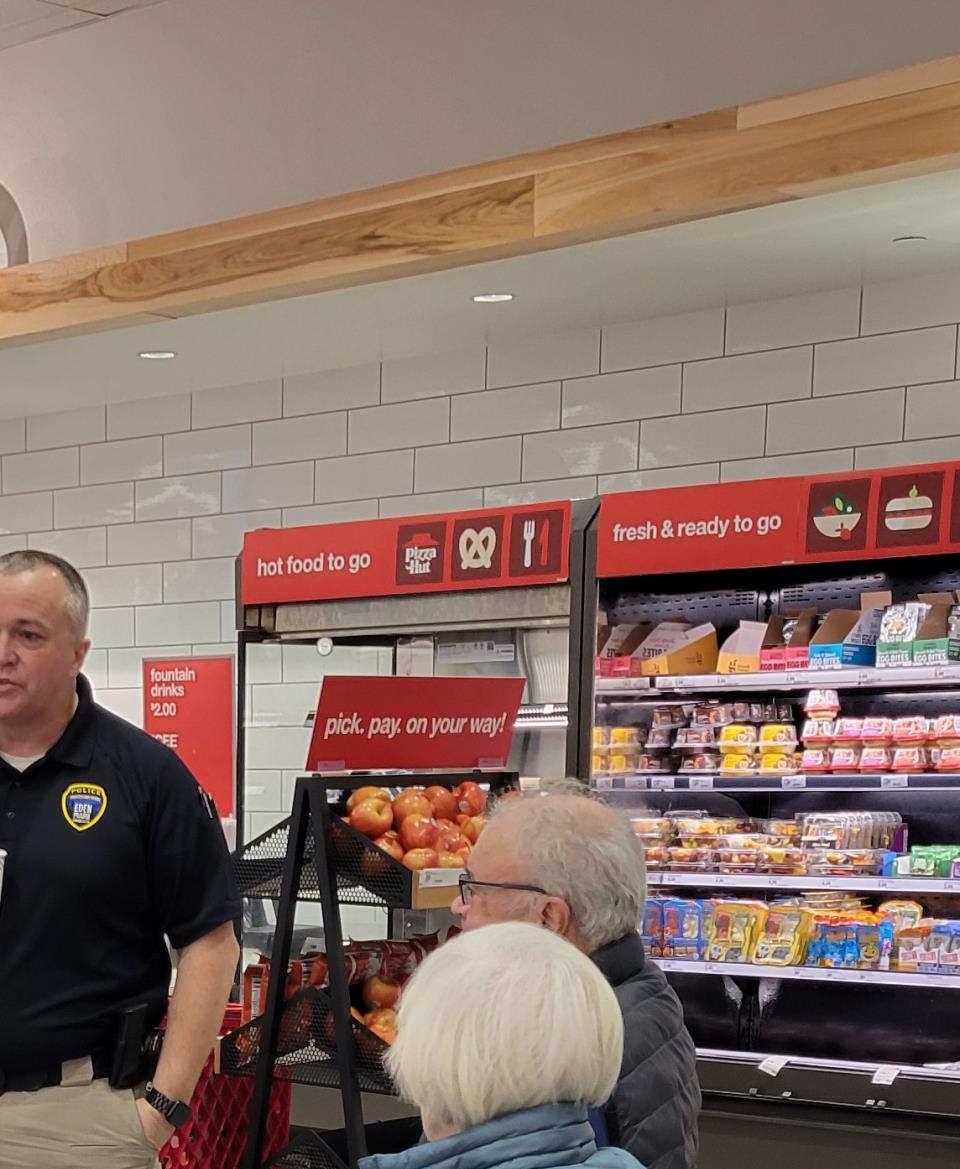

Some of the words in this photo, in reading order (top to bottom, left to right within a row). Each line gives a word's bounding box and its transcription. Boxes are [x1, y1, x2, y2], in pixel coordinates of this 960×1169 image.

[612, 521, 657, 542] fresh
[660, 519, 674, 539] &
[677, 515, 730, 538] ready
[733, 514, 753, 533] to
[757, 514, 782, 535] go
[405, 546, 437, 563] Pizza
[257, 557, 283, 577] hot
[287, 553, 324, 574] food
[328, 552, 345, 570] to
[349, 553, 371, 573] go
[405, 559, 432, 575] Hut
[150, 666, 196, 683] fountain
[150, 683, 185, 697] drinks
[324, 712, 365, 740] pick.
[368, 716, 401, 740] pay.
[406, 716, 428, 735] on
[429, 716, 468, 739] your
[470, 712, 507, 738] way!
[70, 787, 101, 797] POLICE
